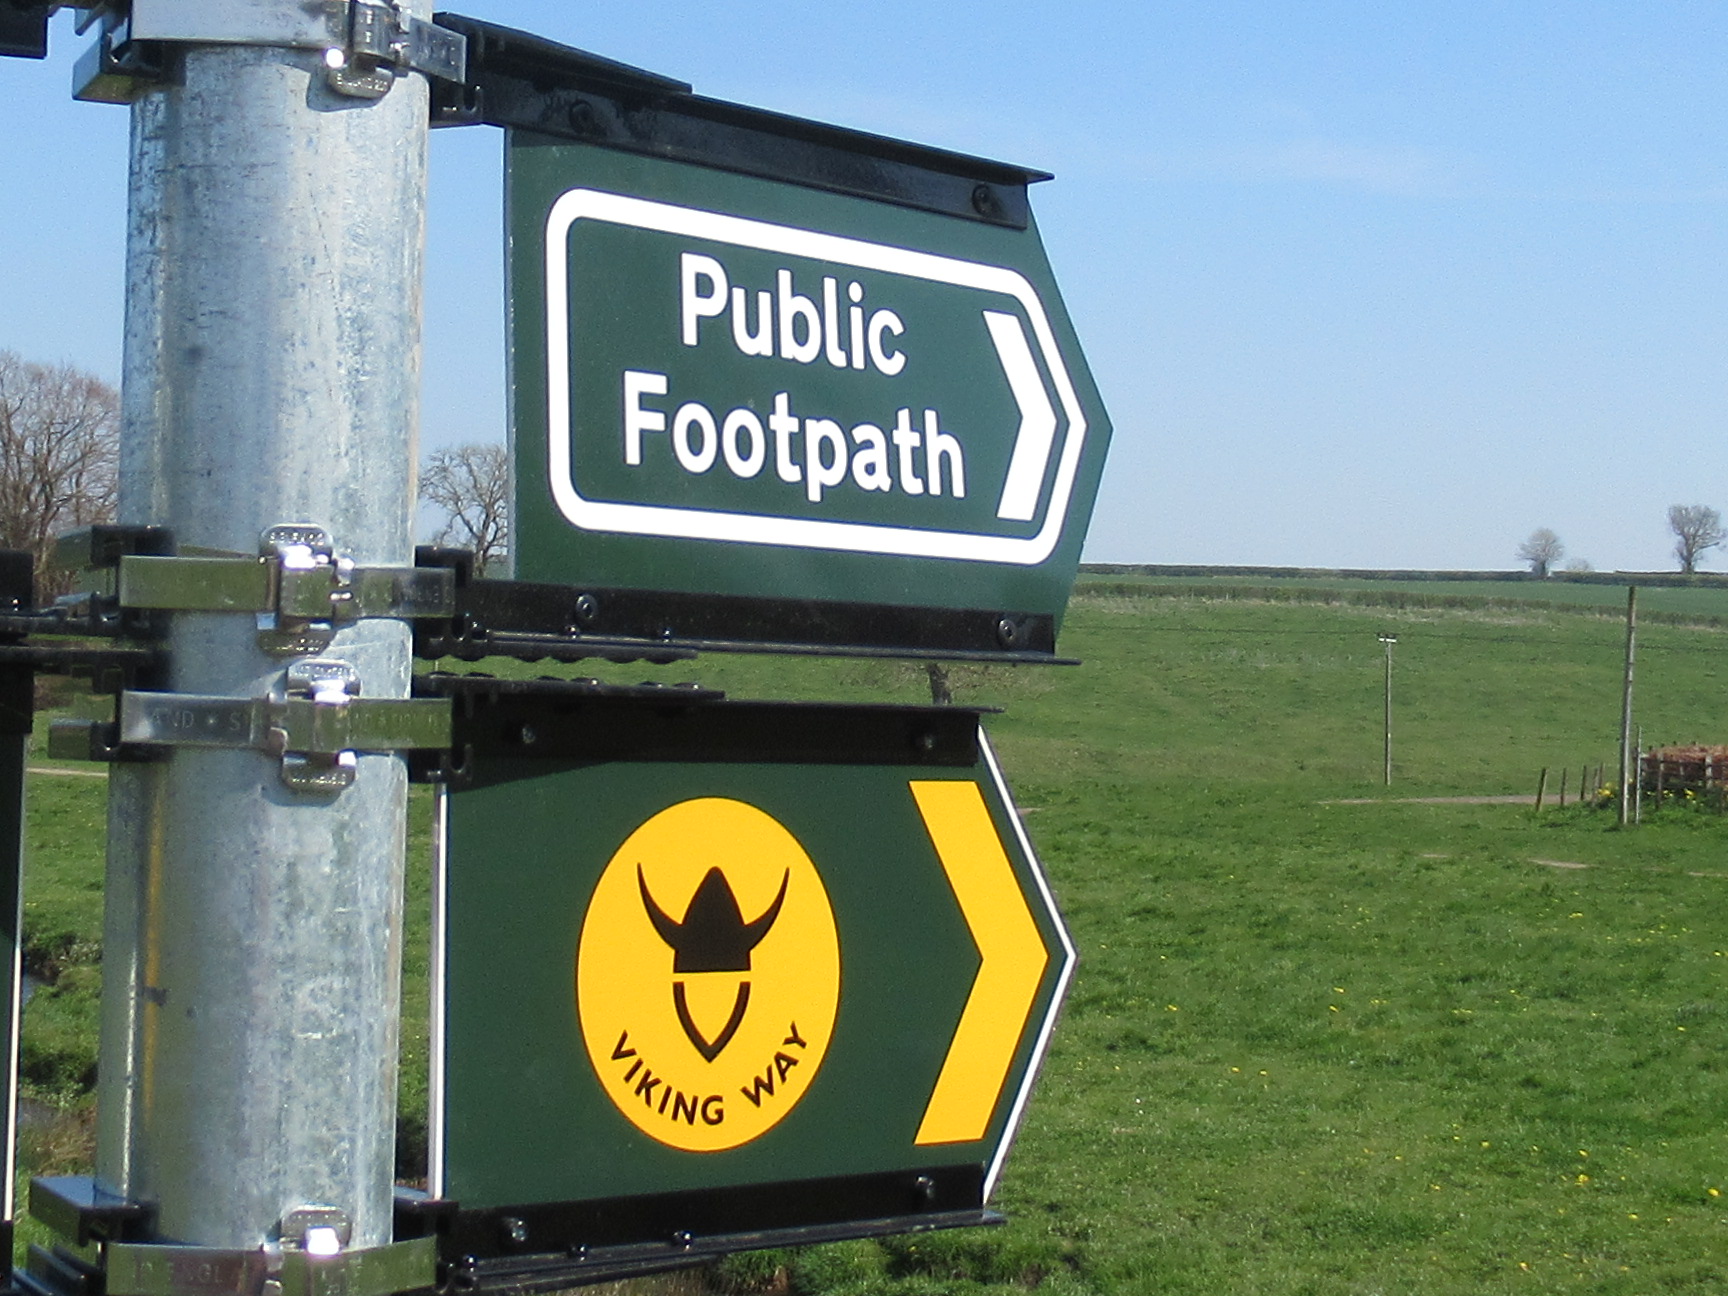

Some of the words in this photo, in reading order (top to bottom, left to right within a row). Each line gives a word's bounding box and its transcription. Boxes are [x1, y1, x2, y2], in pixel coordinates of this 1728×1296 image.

[680, 251, 907, 376] Public
[622, 369, 966, 503] Footpath
[610, 1029, 725, 1126] VIKING
[740, 1020, 808, 1109] WAY
